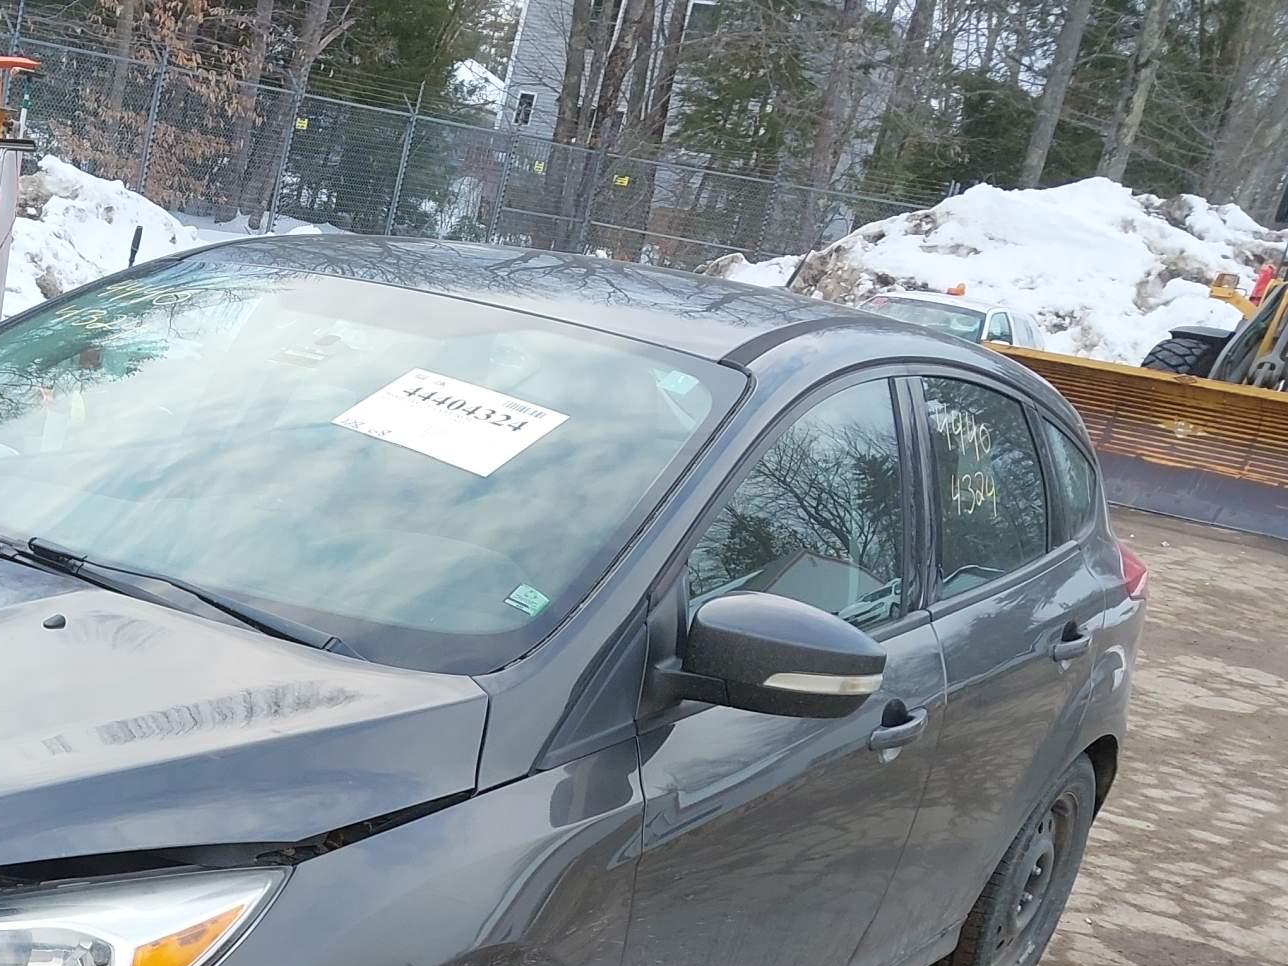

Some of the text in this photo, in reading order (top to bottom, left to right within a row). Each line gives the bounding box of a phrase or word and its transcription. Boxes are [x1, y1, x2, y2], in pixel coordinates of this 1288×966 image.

[402, 386, 529, 432] 44404324
[935, 402, 992, 462] 4440
[951, 471, 998, 518] 4324
